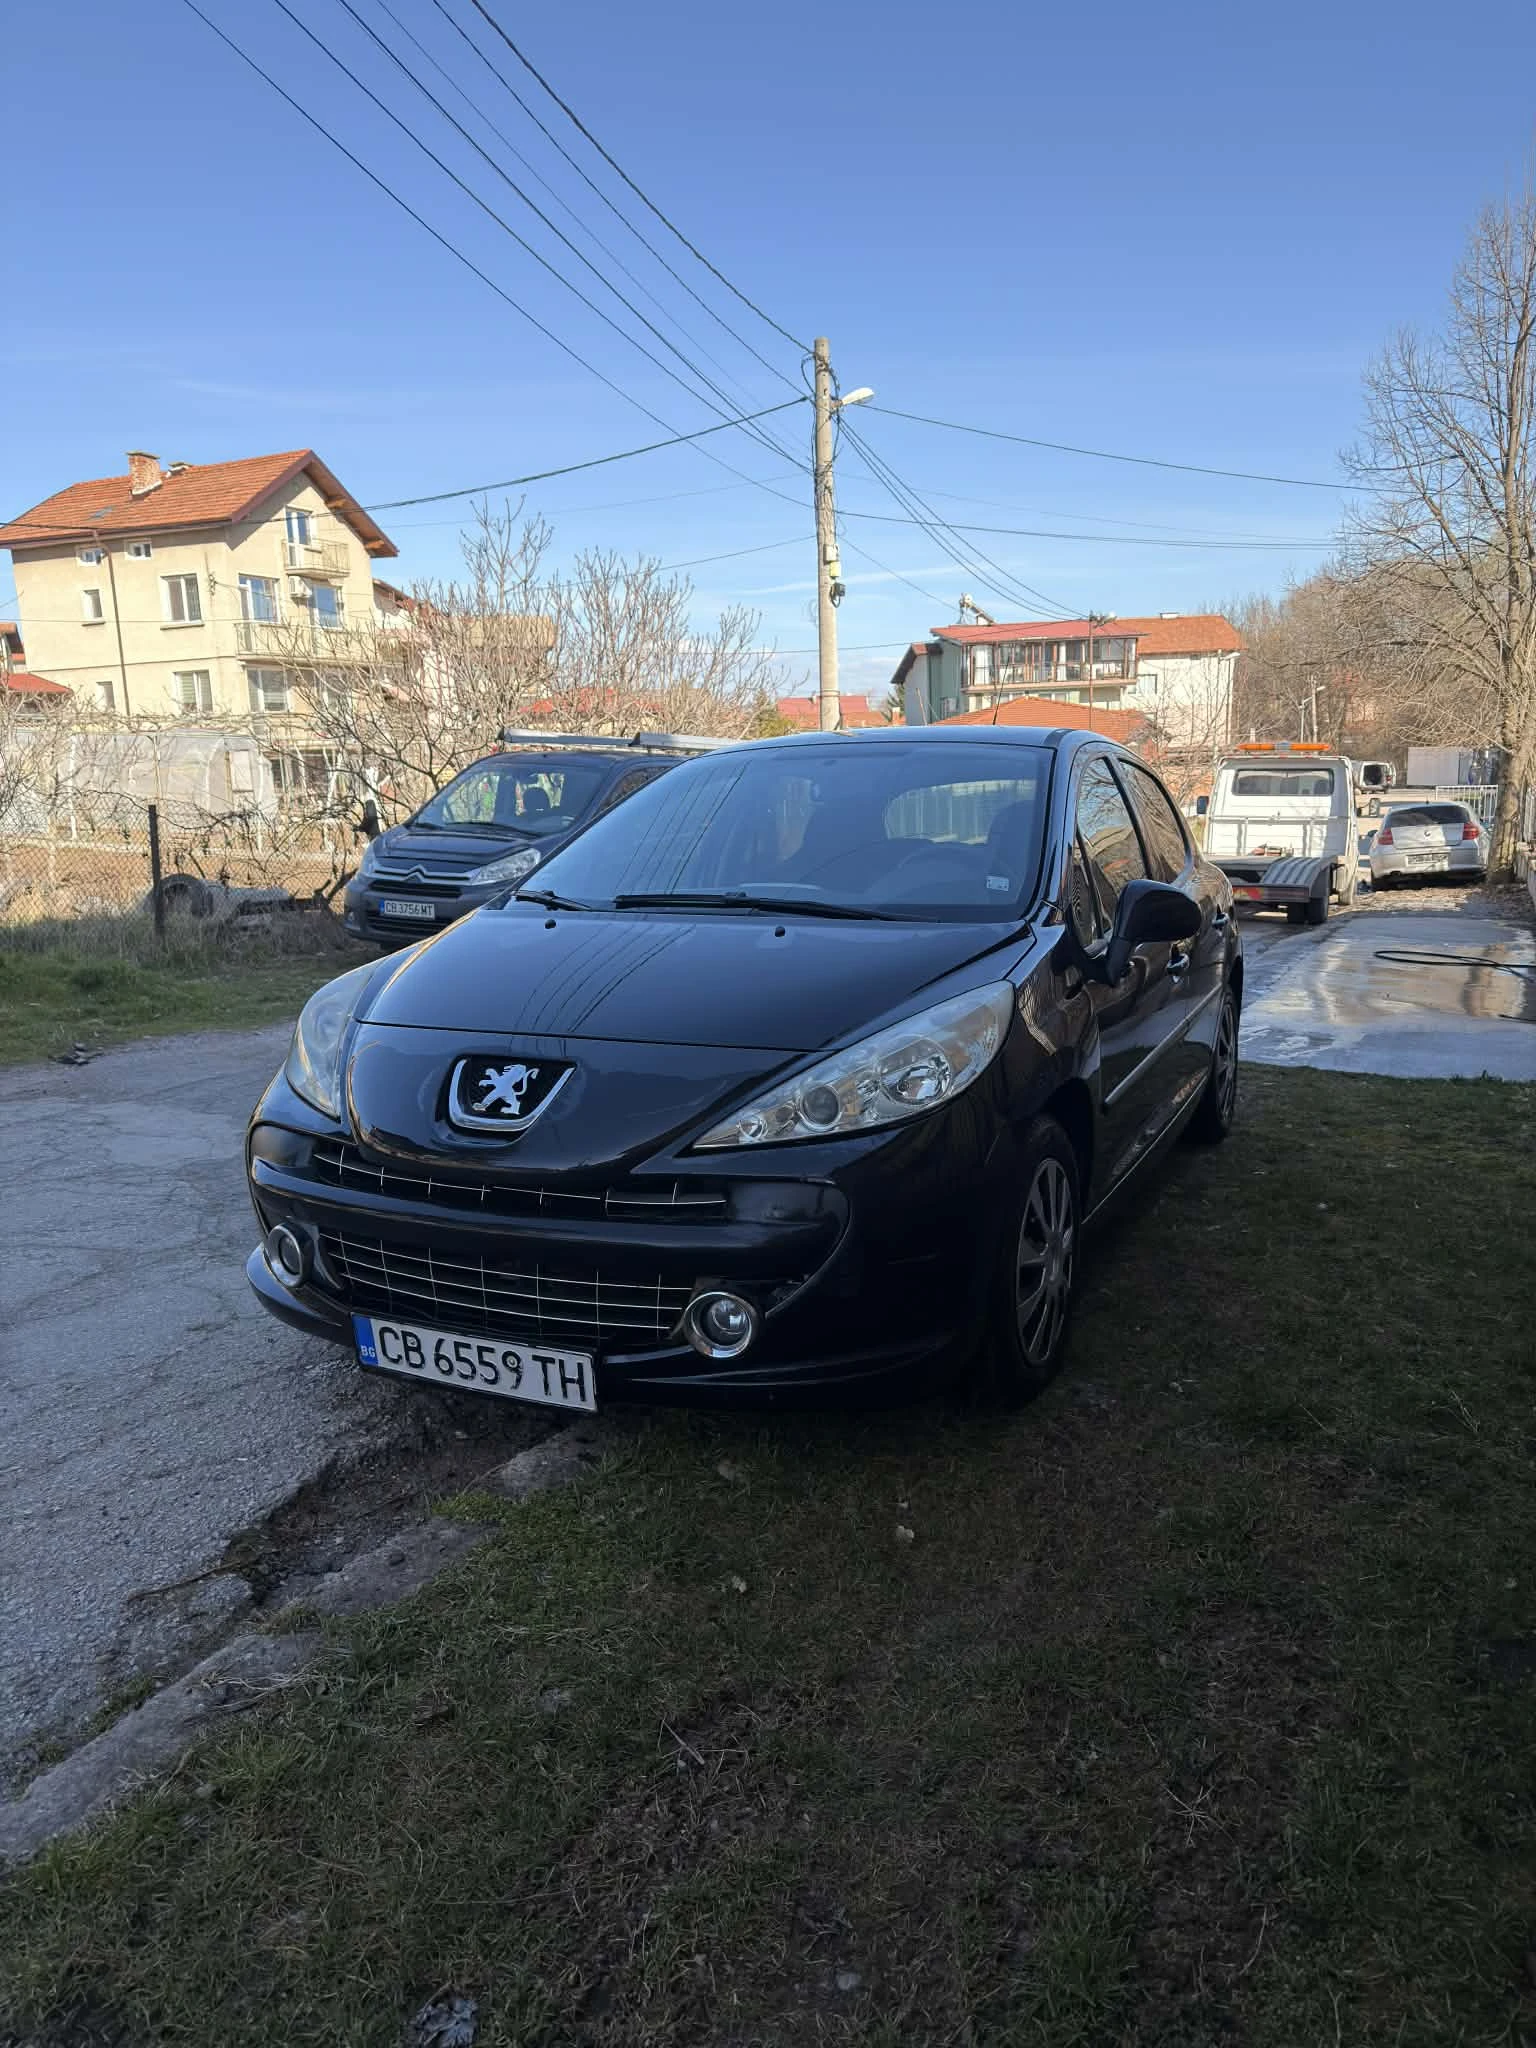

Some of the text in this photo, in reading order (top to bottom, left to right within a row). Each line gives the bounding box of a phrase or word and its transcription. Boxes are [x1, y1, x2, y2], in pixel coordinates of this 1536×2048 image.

[360, 1344, 376, 1358] BG
[378, 1326, 586, 1402] CB 6559 TH
